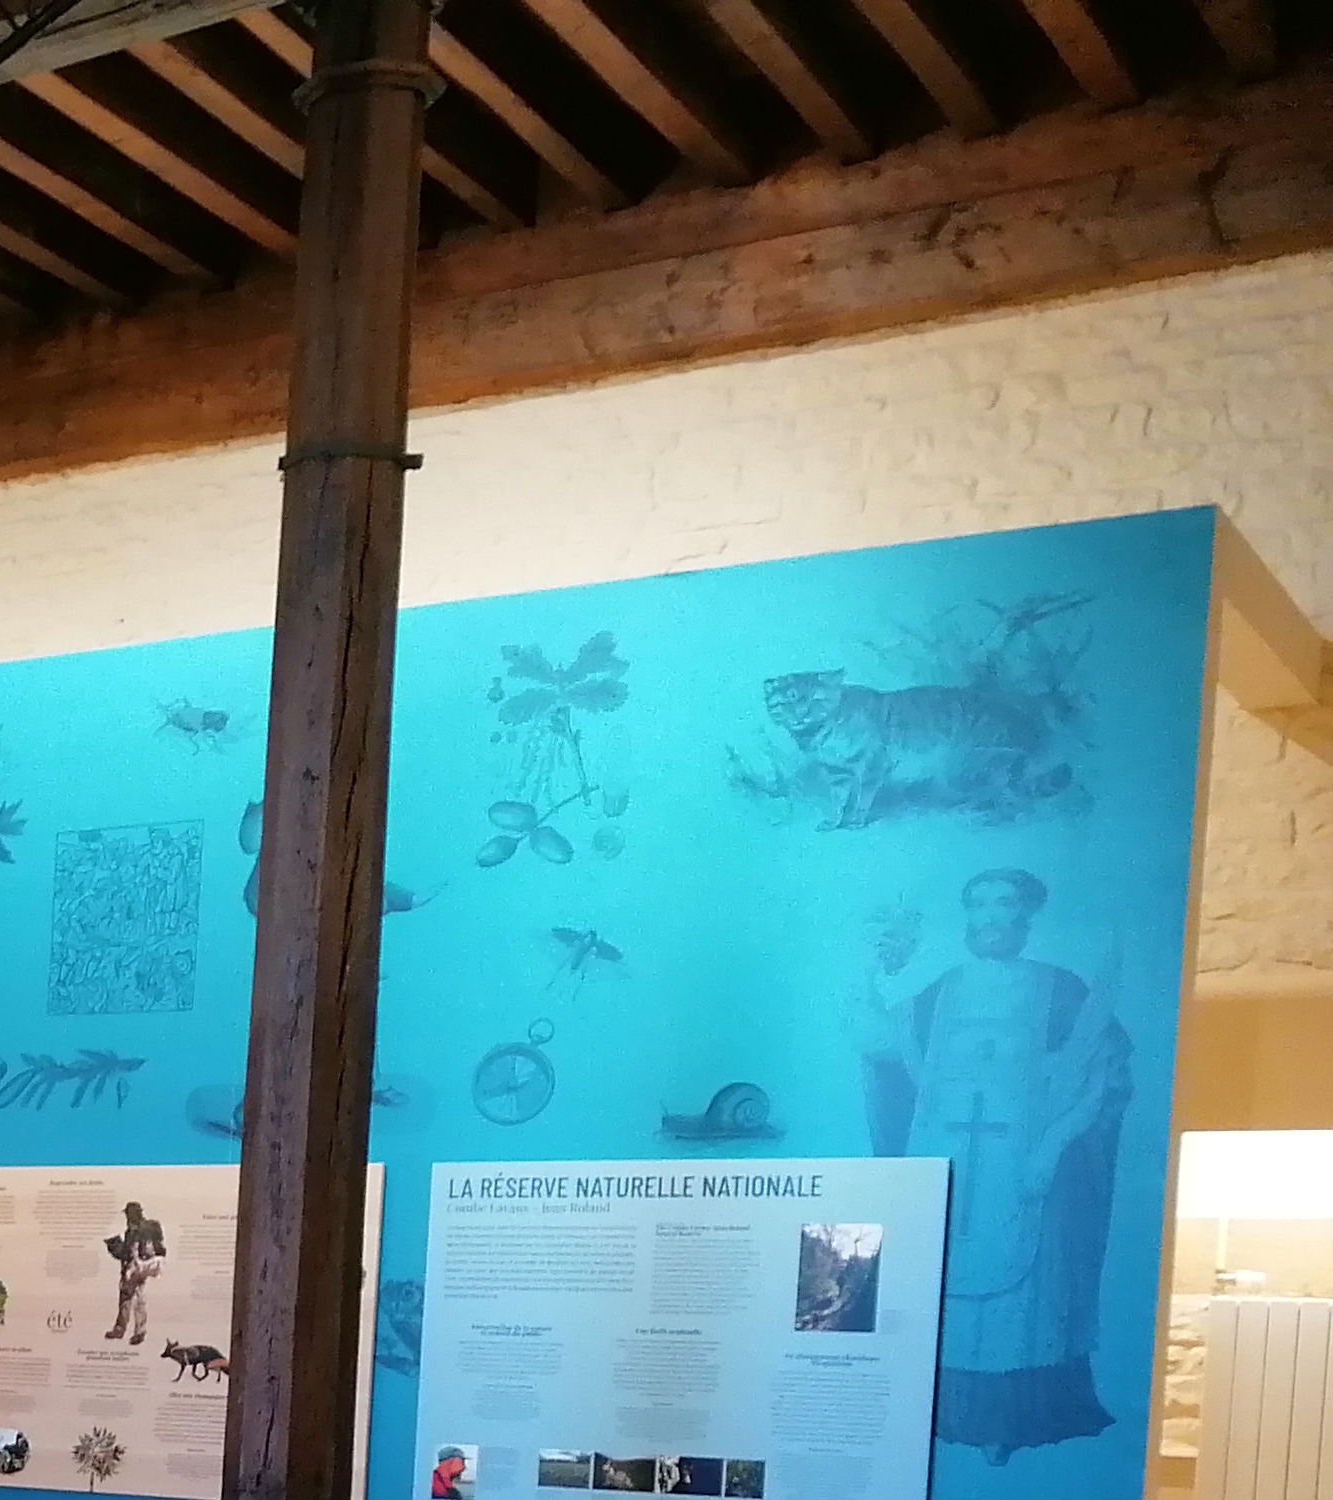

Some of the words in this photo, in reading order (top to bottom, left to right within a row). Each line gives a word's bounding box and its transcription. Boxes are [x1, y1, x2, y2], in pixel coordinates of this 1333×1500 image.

[448, 1177, 474, 1199] LA
[480, 1171, 569, 1199] RÉSERVE
[575, 1175, 695, 1198] NATURELLE
[702, 1174, 823, 1198] NATIONALE
[46, 1309, 73, 1329] été
